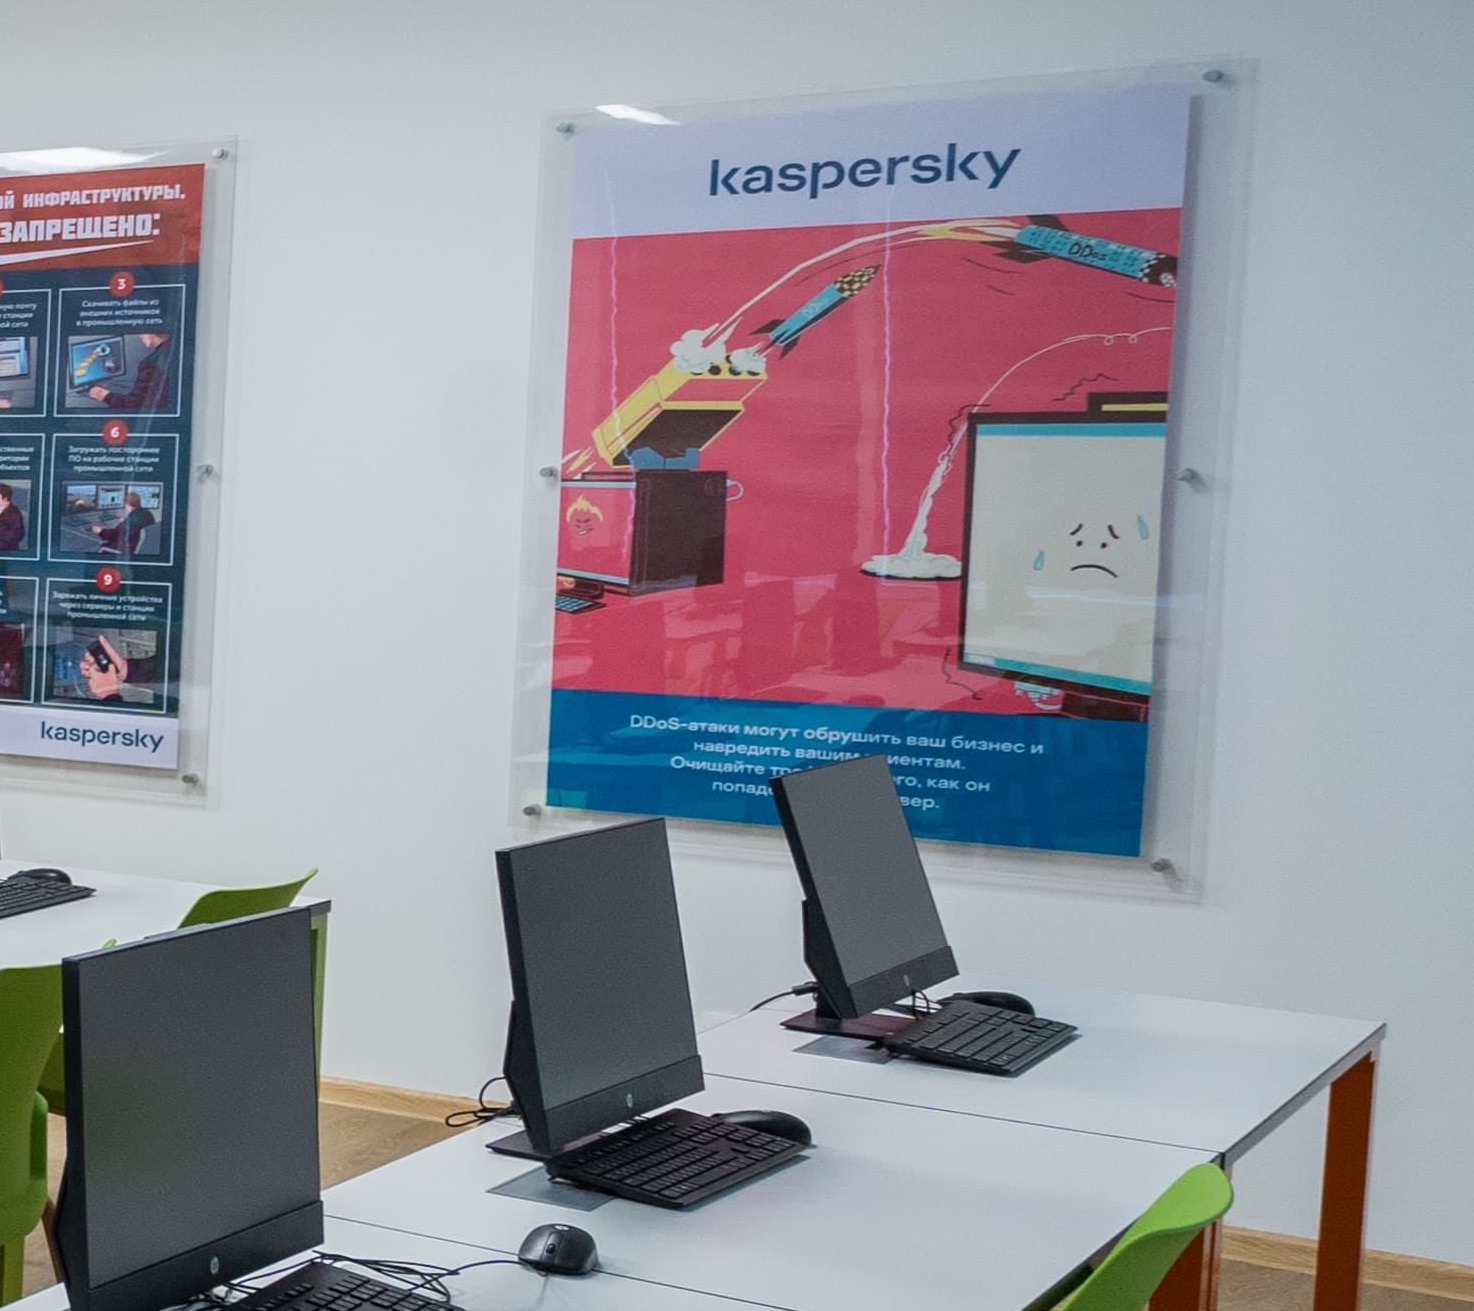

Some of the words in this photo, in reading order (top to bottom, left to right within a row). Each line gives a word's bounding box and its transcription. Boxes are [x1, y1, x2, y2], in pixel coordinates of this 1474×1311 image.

[708, 142, 1023, 200] kaspersky
[23, 183, 186, 208] ИНФРАСТРУКТУРЫ.
[117, 278, 126, 290] 3
[110, 426, 120, 439] 6
[104, 573, 113, 586] 9
[40, 720, 165, 754] kaspersky
[629, 714, 741, 735] DDoS-атаки
[743, 724, 800, 741] могут
[802, 727, 901, 745] обрушить
[906, 736, 947, 748] ваш
[951, 735, 1026, 754] бизнес
[1030, 743, 1044, 755] и
[693, 741, 791, 758] навредить
[866, 754, 967, 770] иентам.
[670, 755, 766, 775] Очищайте
[926, 777, 960, 790] как
[965, 780, 991, 792] он
[712, 781, 774, 797] попад
[899, 795, 941, 811] вер.
